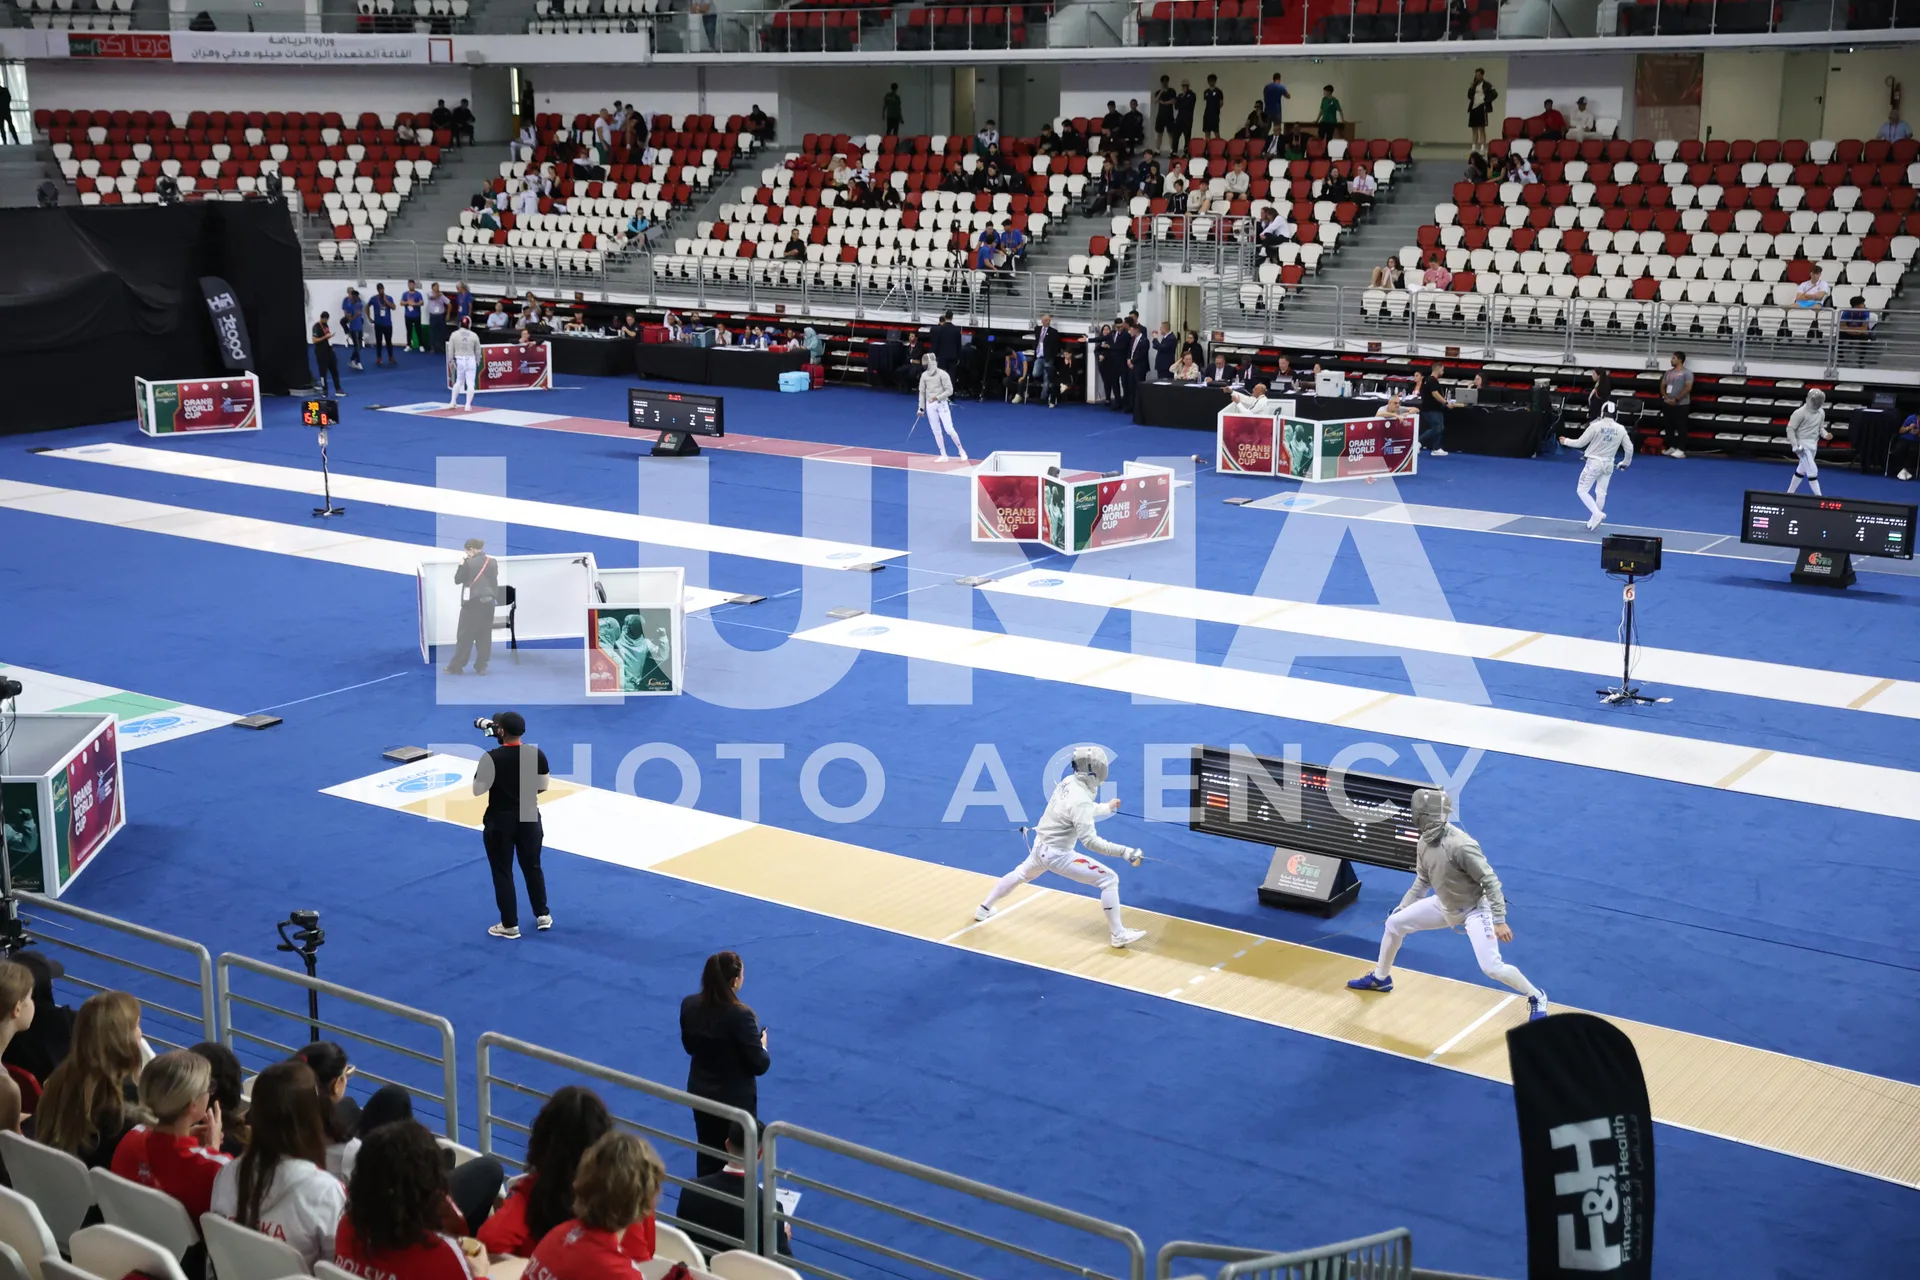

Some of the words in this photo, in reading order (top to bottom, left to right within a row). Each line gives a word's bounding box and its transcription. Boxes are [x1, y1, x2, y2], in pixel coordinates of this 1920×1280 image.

[1238, 444, 1263, 452] ORAN
[1348, 440, 1370, 448] ORAN
[1348, 446, 1375, 454] WORLD
[1238, 451, 1270, 460] WORLD
[1237, 457, 1256, 466] CUP
[997, 508, 1027, 516] ORAN
[1101, 502, 1124, 513] ORAN
[997, 516, 1036, 525] WORLD
[1102, 510, 1130, 521] WORLD
[997, 524, 1019, 533] CUP
[1101, 520, 1118, 531] CUP
[1855, 526, 1865, 542] 4
[1625, 587, 1634, 599] 6
[1612, 1114, 1630, 1176] Health
[1620, 1179, 1631, 1192] &
[1620, 1195, 1632, 1262] Fitness
